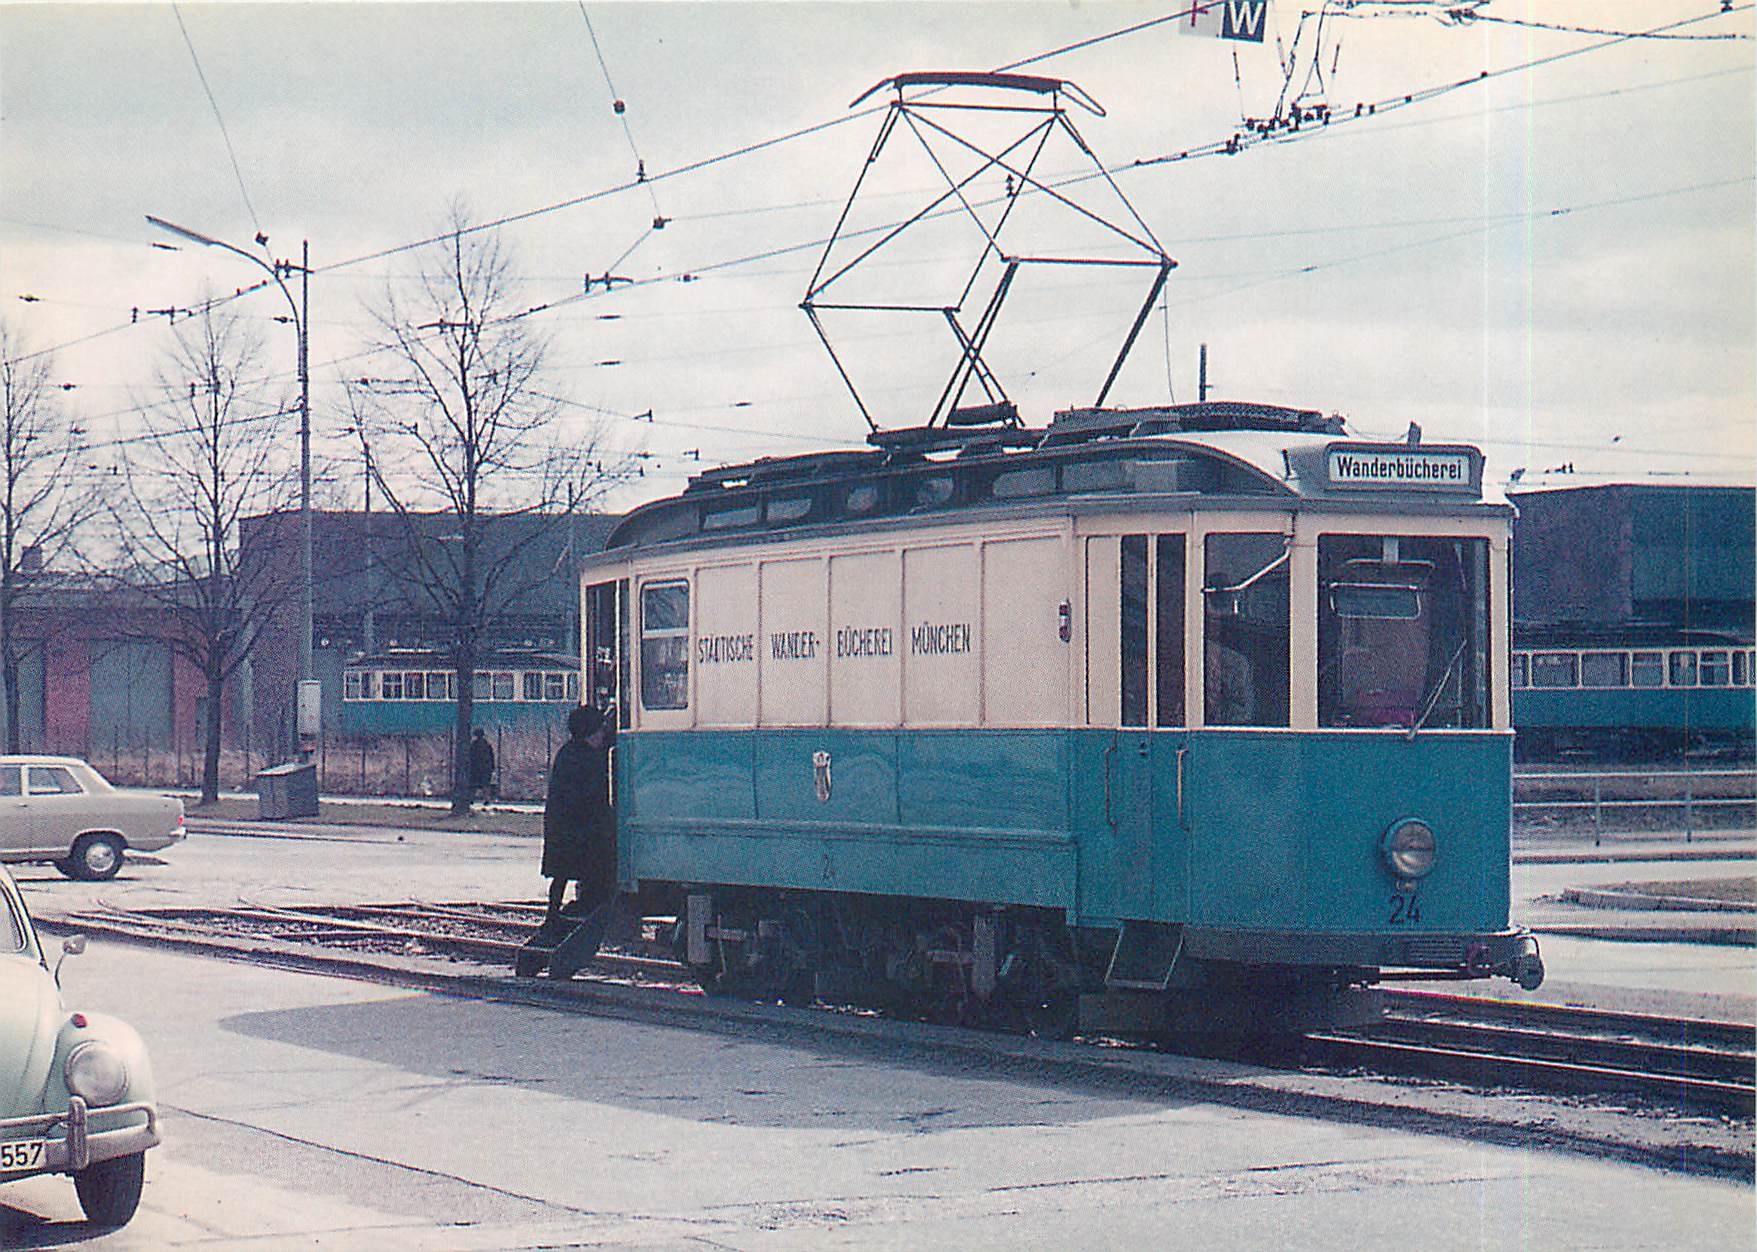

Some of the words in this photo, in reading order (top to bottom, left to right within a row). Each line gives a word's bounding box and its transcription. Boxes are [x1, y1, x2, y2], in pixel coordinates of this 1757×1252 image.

[1229, 0, 1265, 35] W
[1337, 456, 1462, 480] Wanderbücherei
[837, 625, 892, 657] BÜCHEREI
[911, 621, 970, 656] MÜNCHEN
[1389, 894, 1421, 924] 24
[1, 1142, 42, 1167] 557
